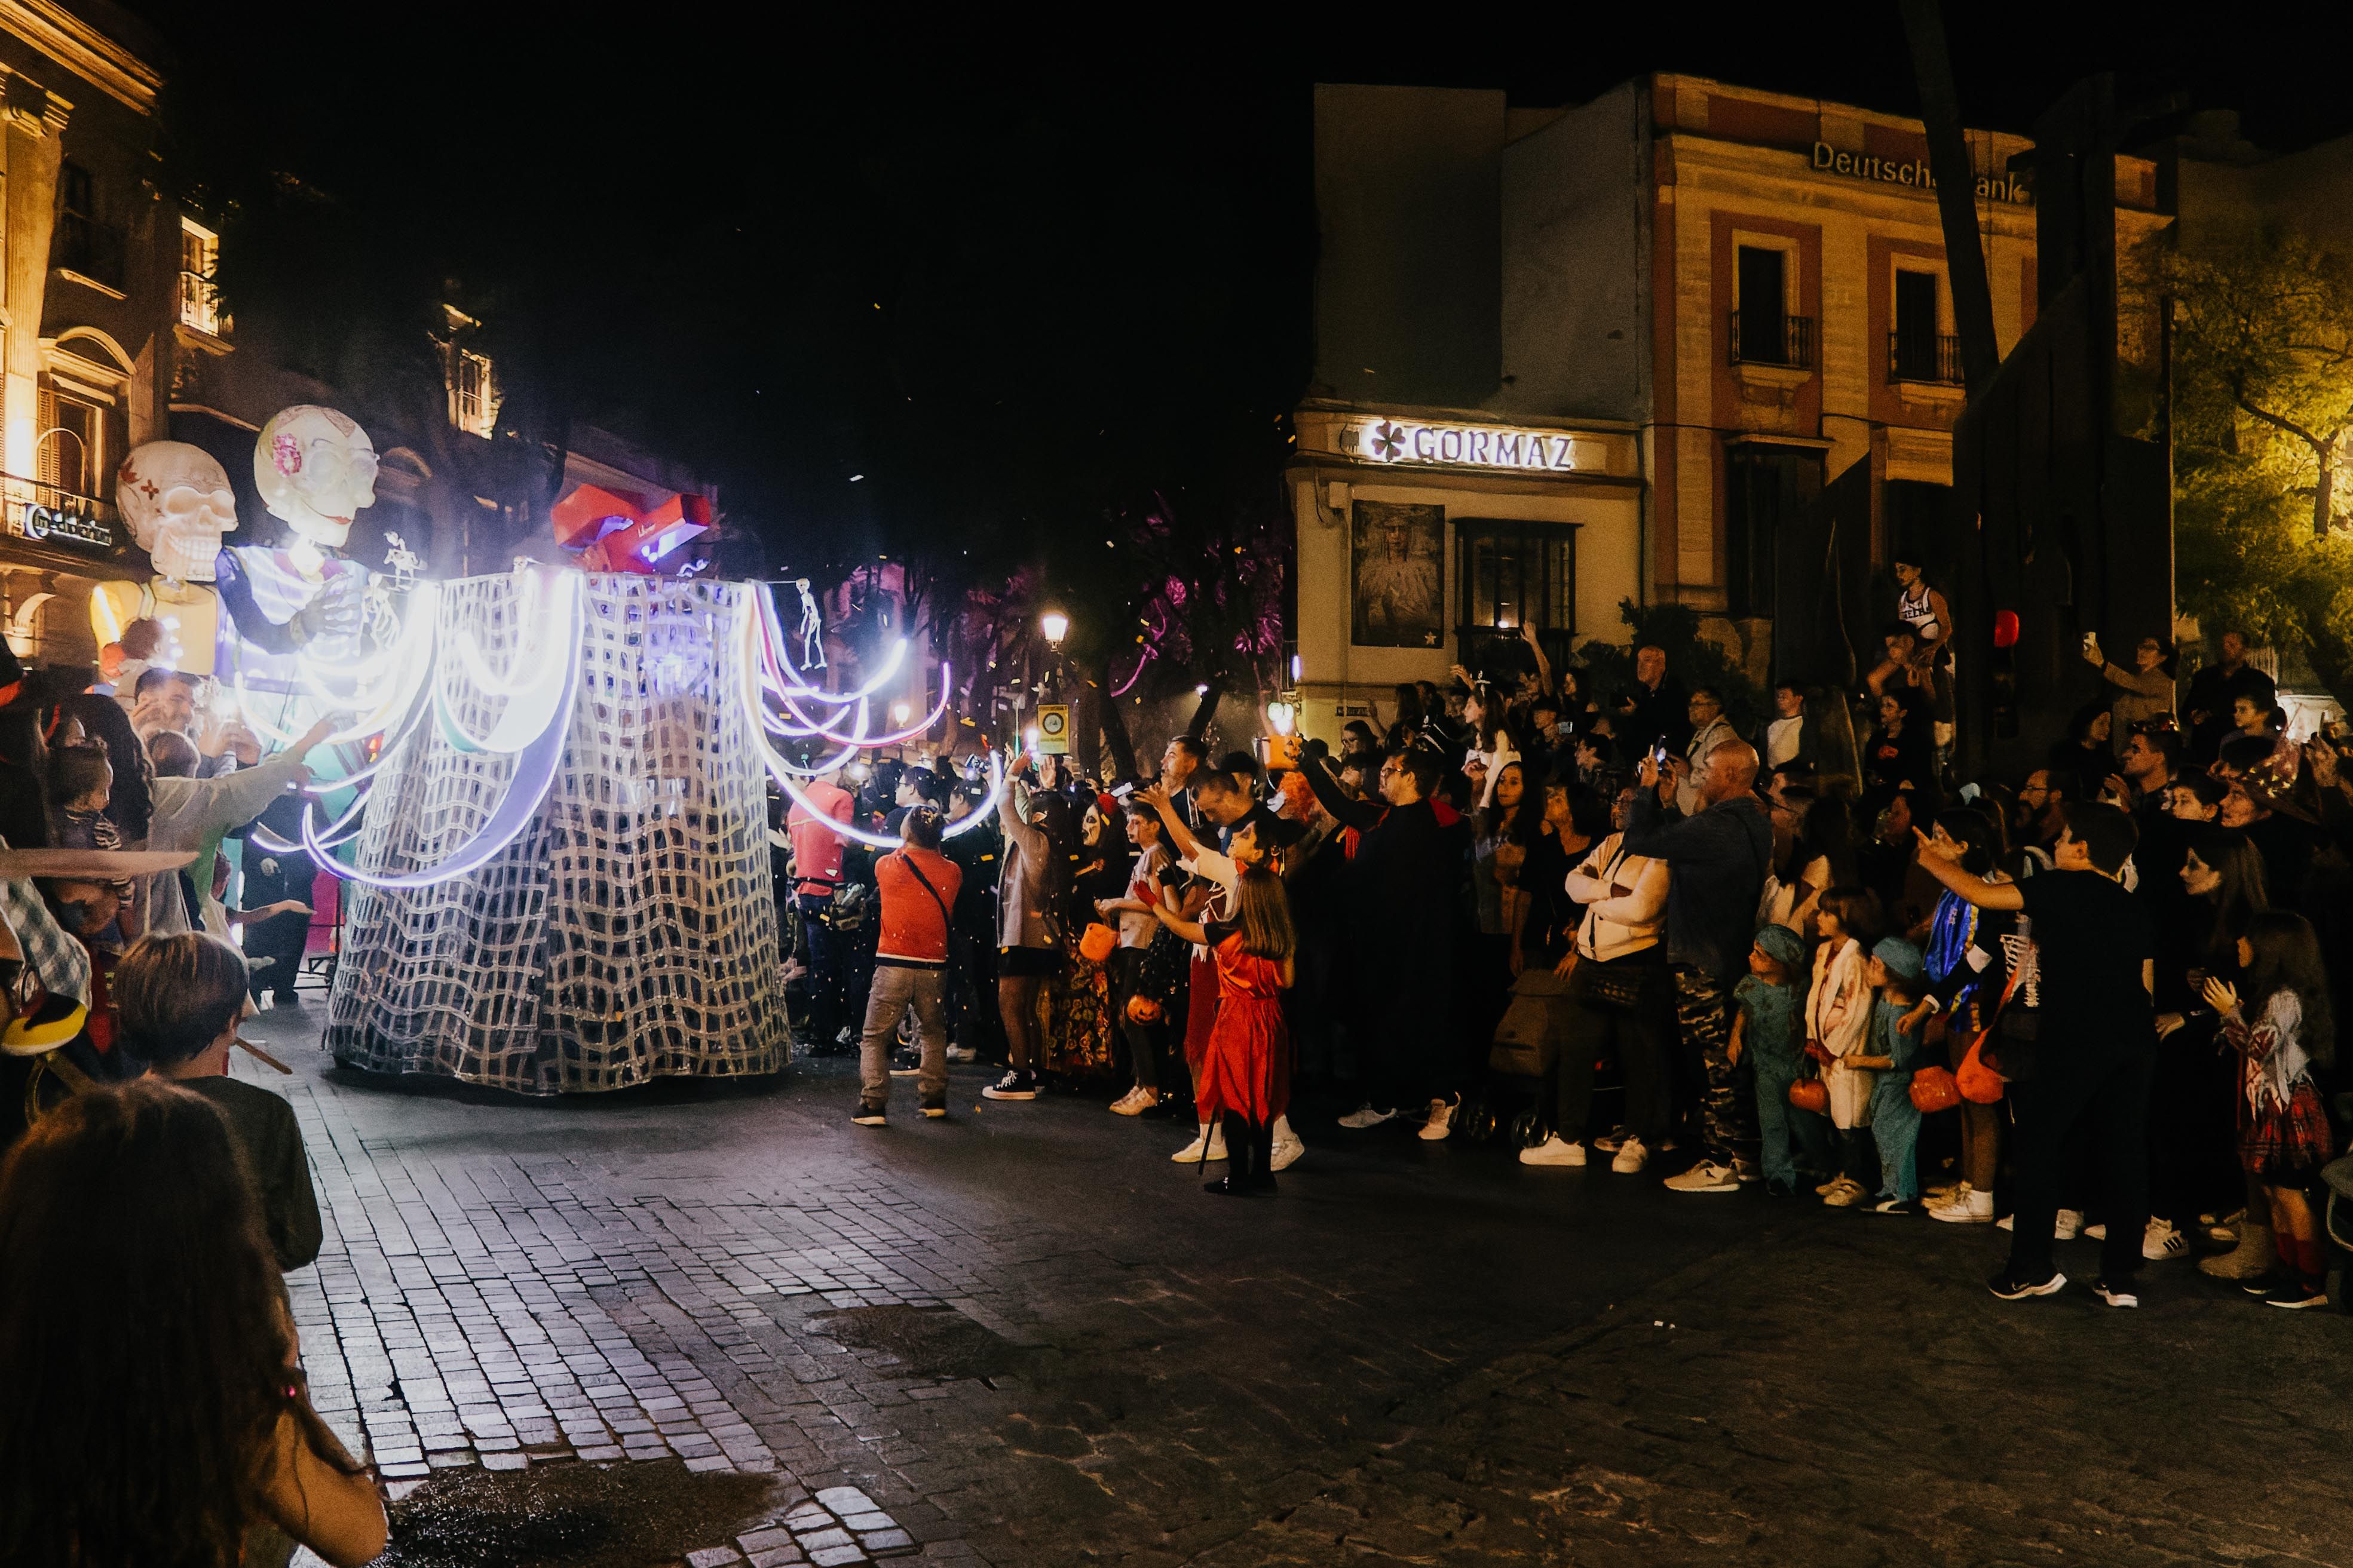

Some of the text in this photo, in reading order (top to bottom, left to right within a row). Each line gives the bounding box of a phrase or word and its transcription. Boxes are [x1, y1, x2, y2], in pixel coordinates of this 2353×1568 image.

[1814, 141, 2030, 203] Deutsch ank
[1414, 427, 1571, 467] GORMAZ
